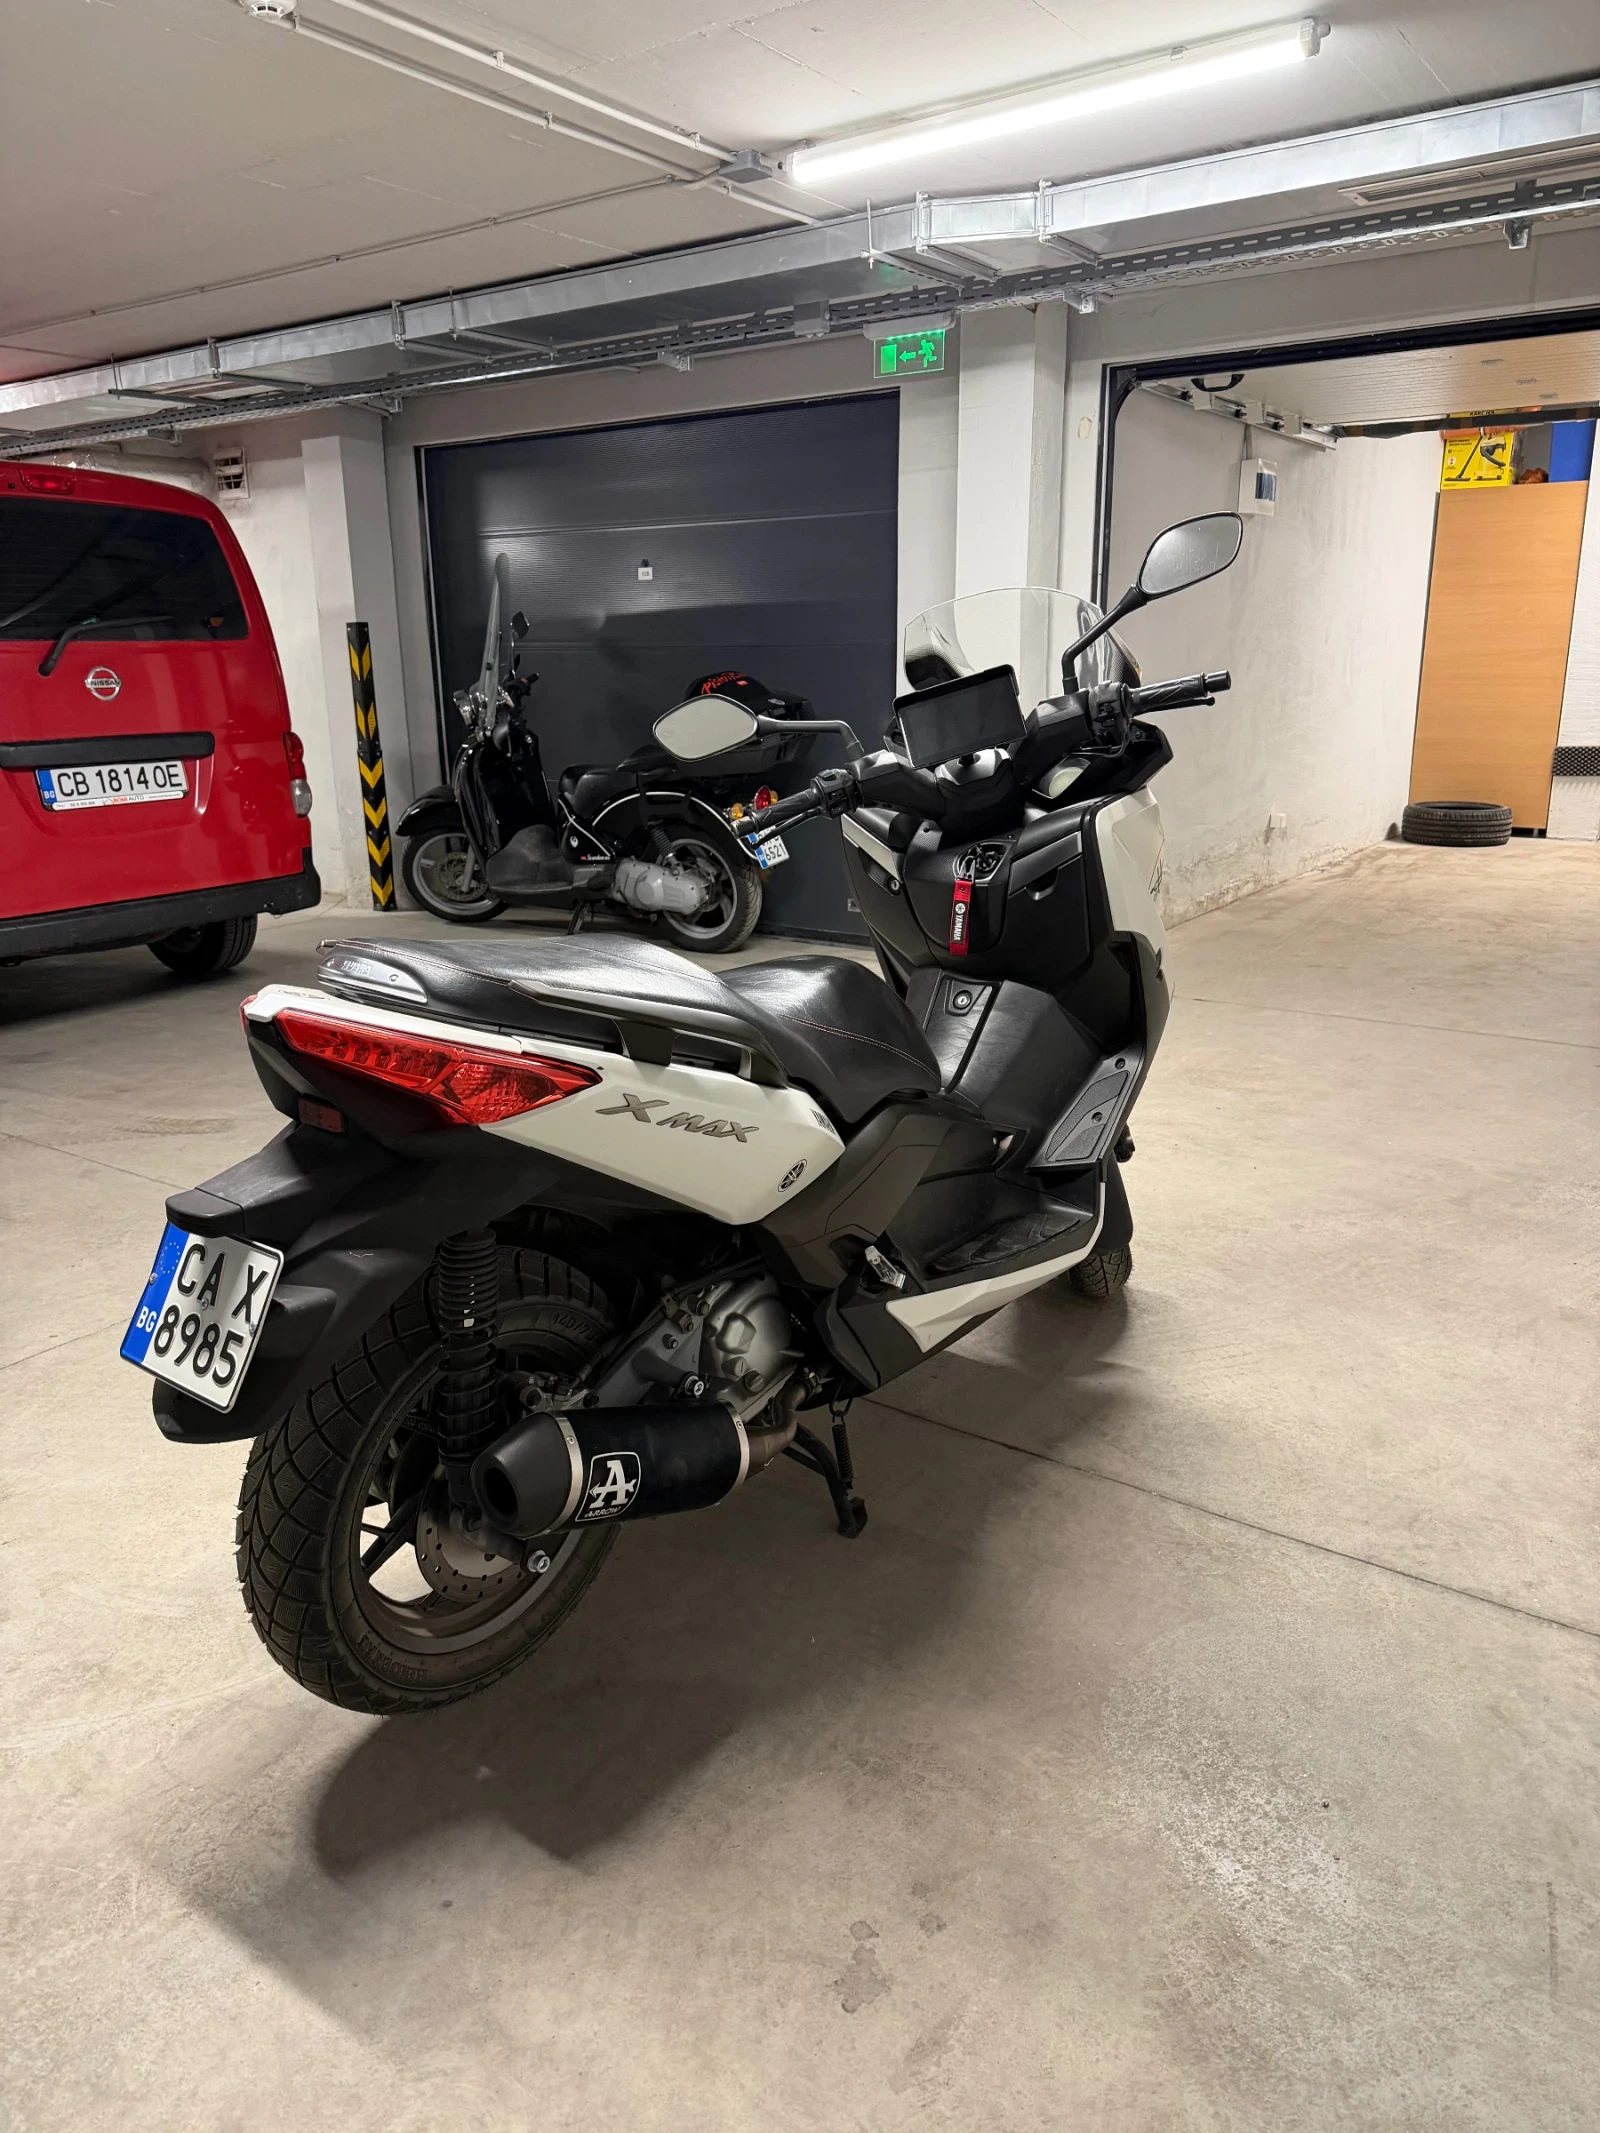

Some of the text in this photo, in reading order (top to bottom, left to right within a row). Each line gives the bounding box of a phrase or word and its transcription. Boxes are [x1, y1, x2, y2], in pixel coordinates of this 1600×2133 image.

[90, 679, 120, 687] NISSAN
[44, 790, 55, 799] BG
[57, 771, 90, 797] CB
[95, 766, 149, 793] 1814
[953, 914, 964, 941] YAMAHA
[136, 1306, 157, 1333] BG
[154, 1304, 245, 1387] 8985
[584, 1506, 621, 1518] ARROW
